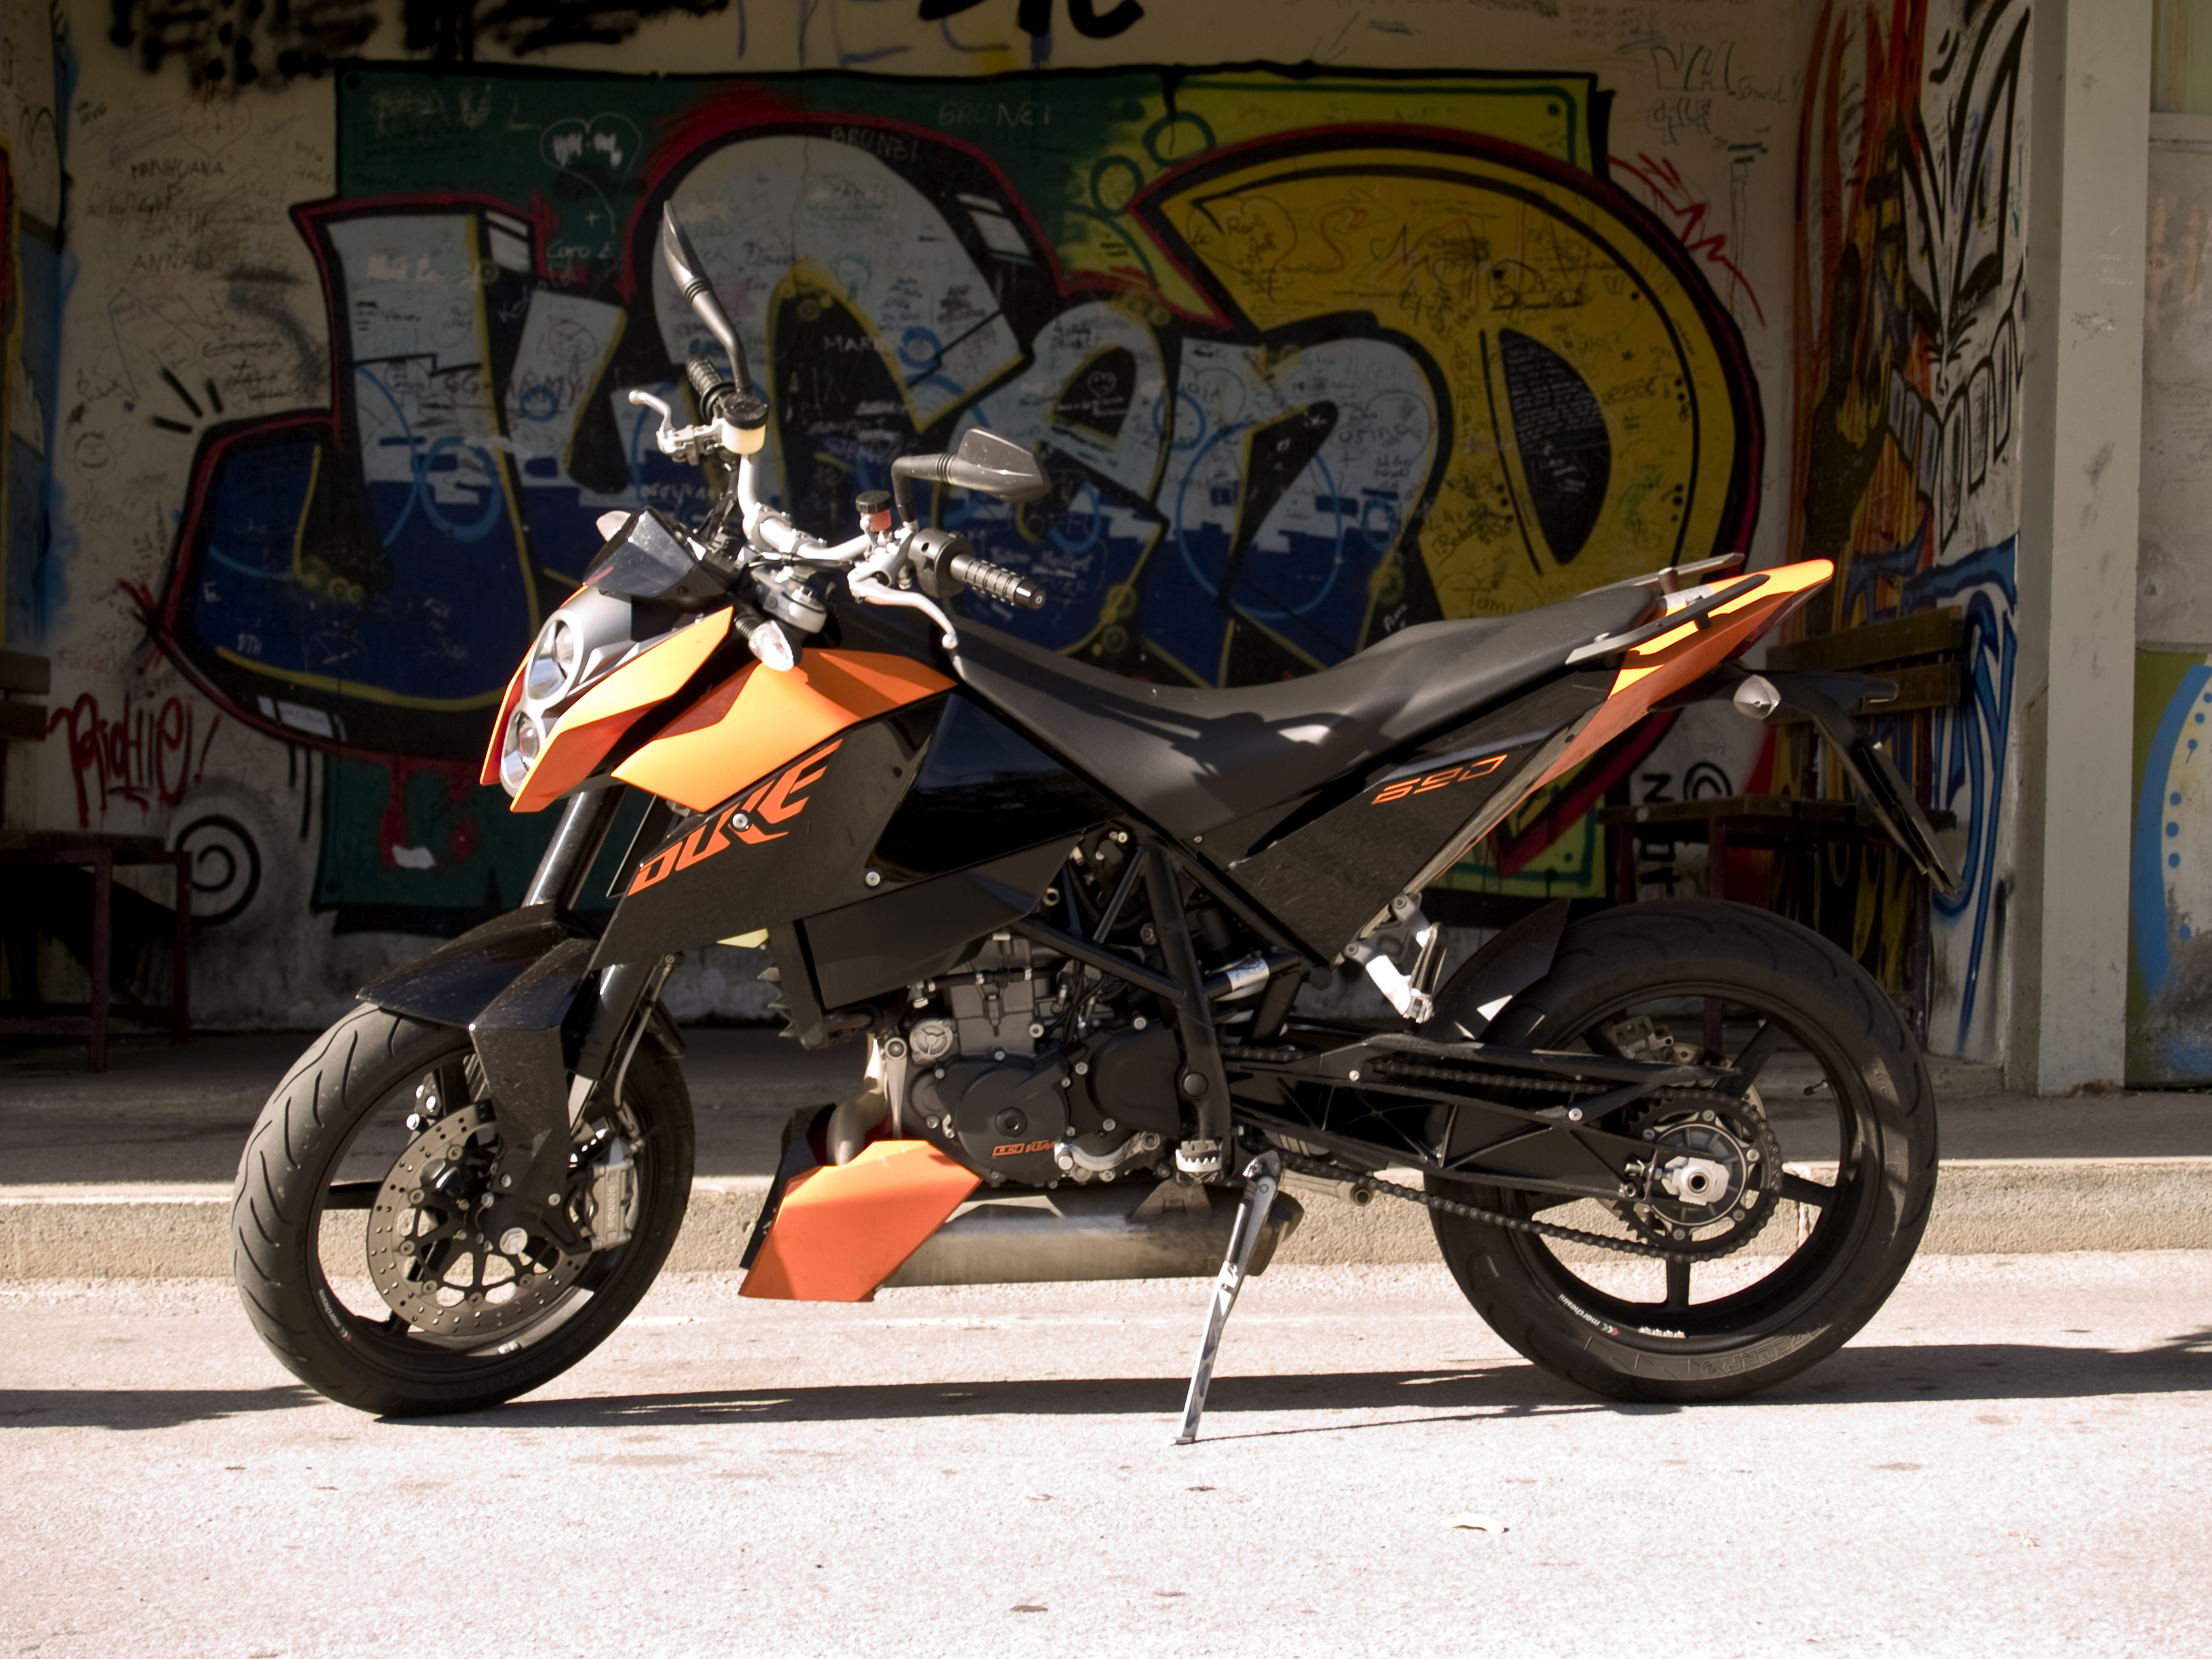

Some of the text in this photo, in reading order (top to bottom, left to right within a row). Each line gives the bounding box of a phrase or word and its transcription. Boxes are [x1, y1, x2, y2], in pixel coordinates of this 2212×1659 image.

[938, 102, 1051, 127] BRUNEI
[830, 125, 920, 162] BRUNEI
[628, 738, 843, 897] DUKE
[1025, 1140, 1056, 1153] KTM
[607, 1185, 618, 1228] brembo
[1558, 1293, 1601, 1326] marchesini
